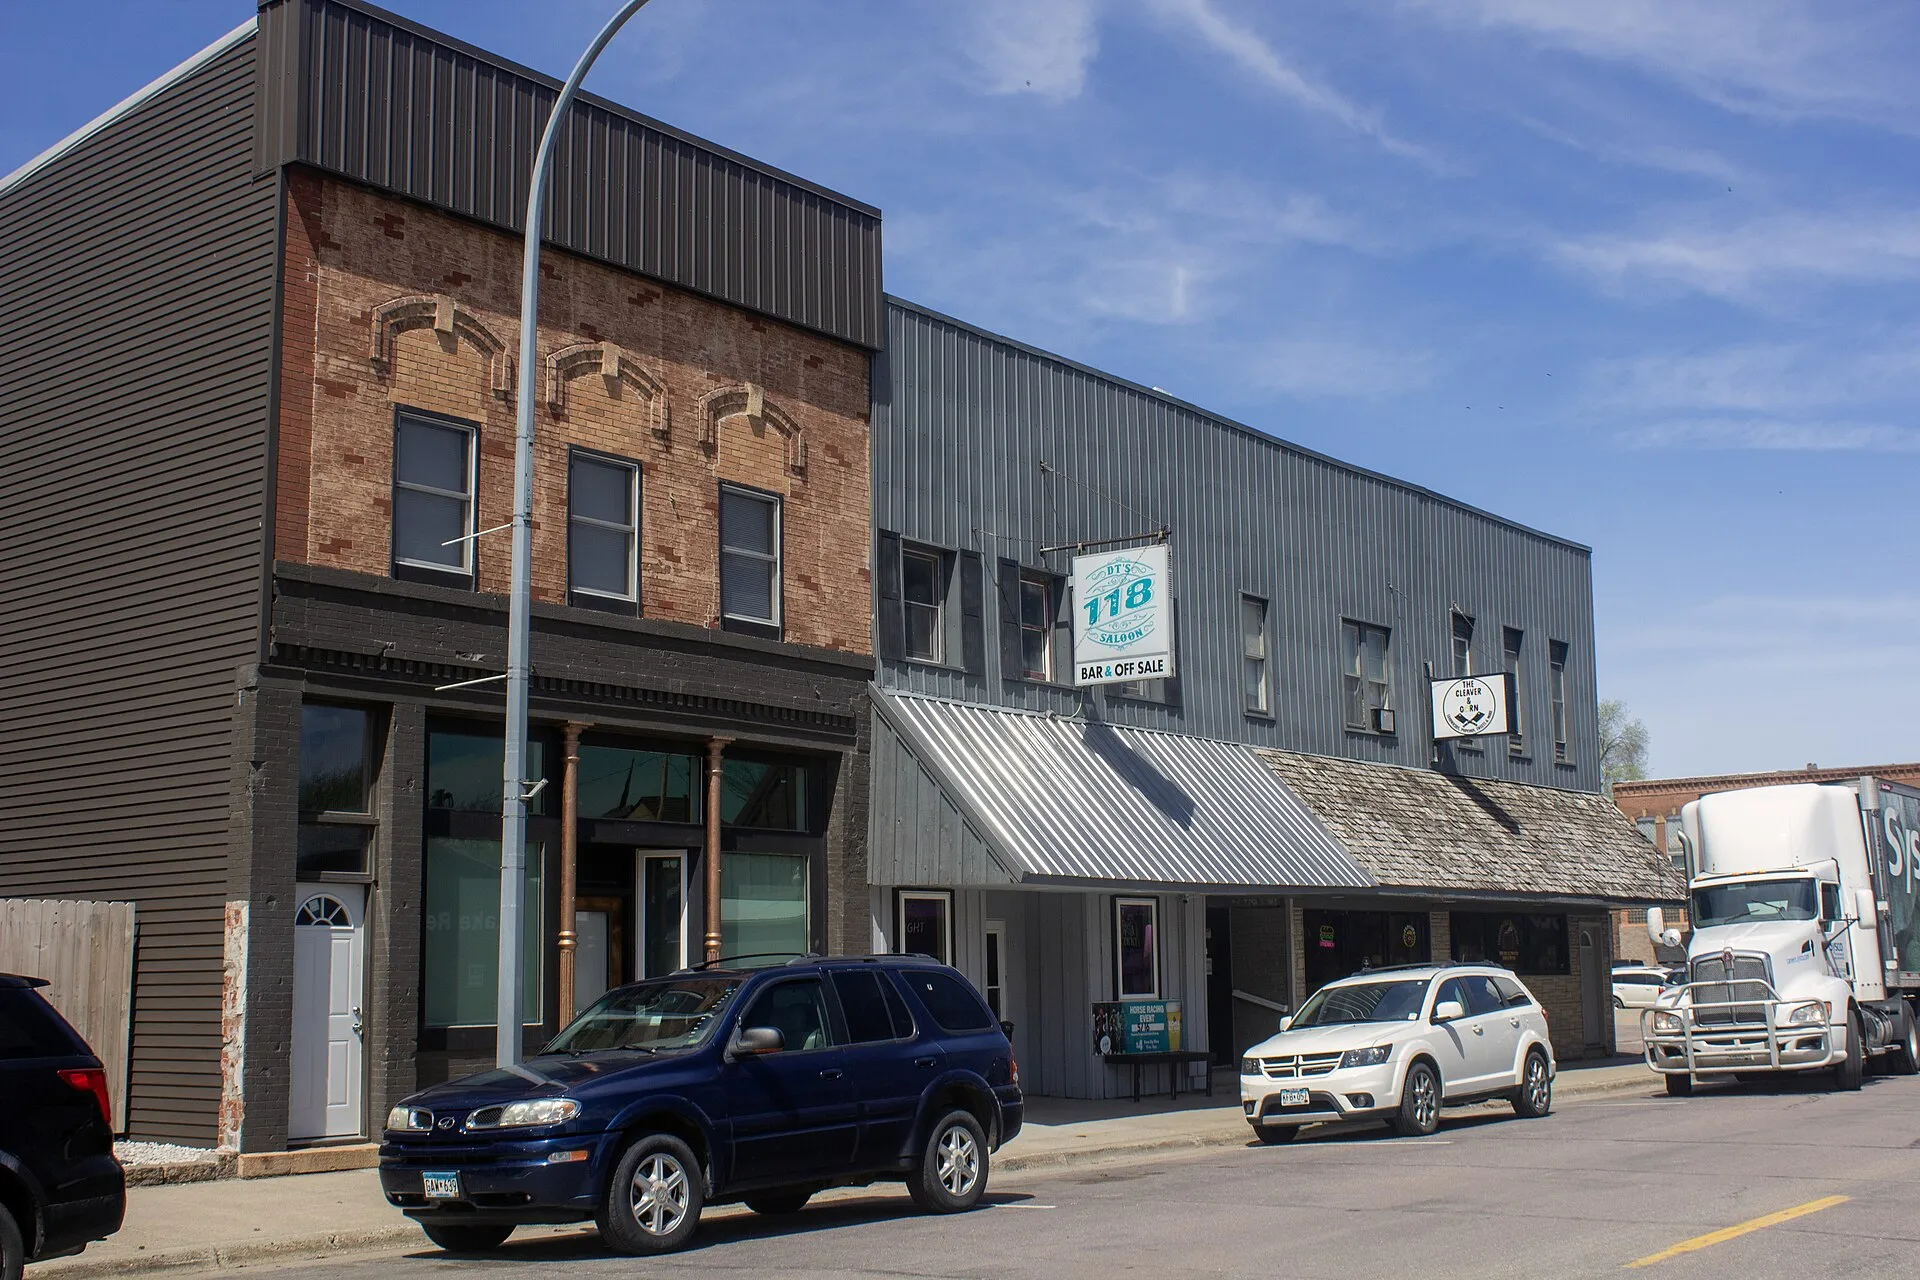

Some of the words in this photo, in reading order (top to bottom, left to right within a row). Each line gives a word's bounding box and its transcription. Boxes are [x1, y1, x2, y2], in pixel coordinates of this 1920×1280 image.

[1107, 563, 1131, 576] DT'S
[1084, 577, 1155, 626] 118
[1099, 628, 1144, 644] SALOON
[1081, 665, 1103, 680] BAR
[1104, 665, 1113, 677] &
[1114, 662, 1135, 677] OFF
[1137, 659, 1164, 674] SALE
[1462, 680, 1474, 688] THE
[1456, 688, 1482, 697] CLEAVER
[1466, 697, 1472, 705] &
[1129, 1006, 1146, 1014] HORSE
[1139, 1014, 1155, 1023] EVENT
